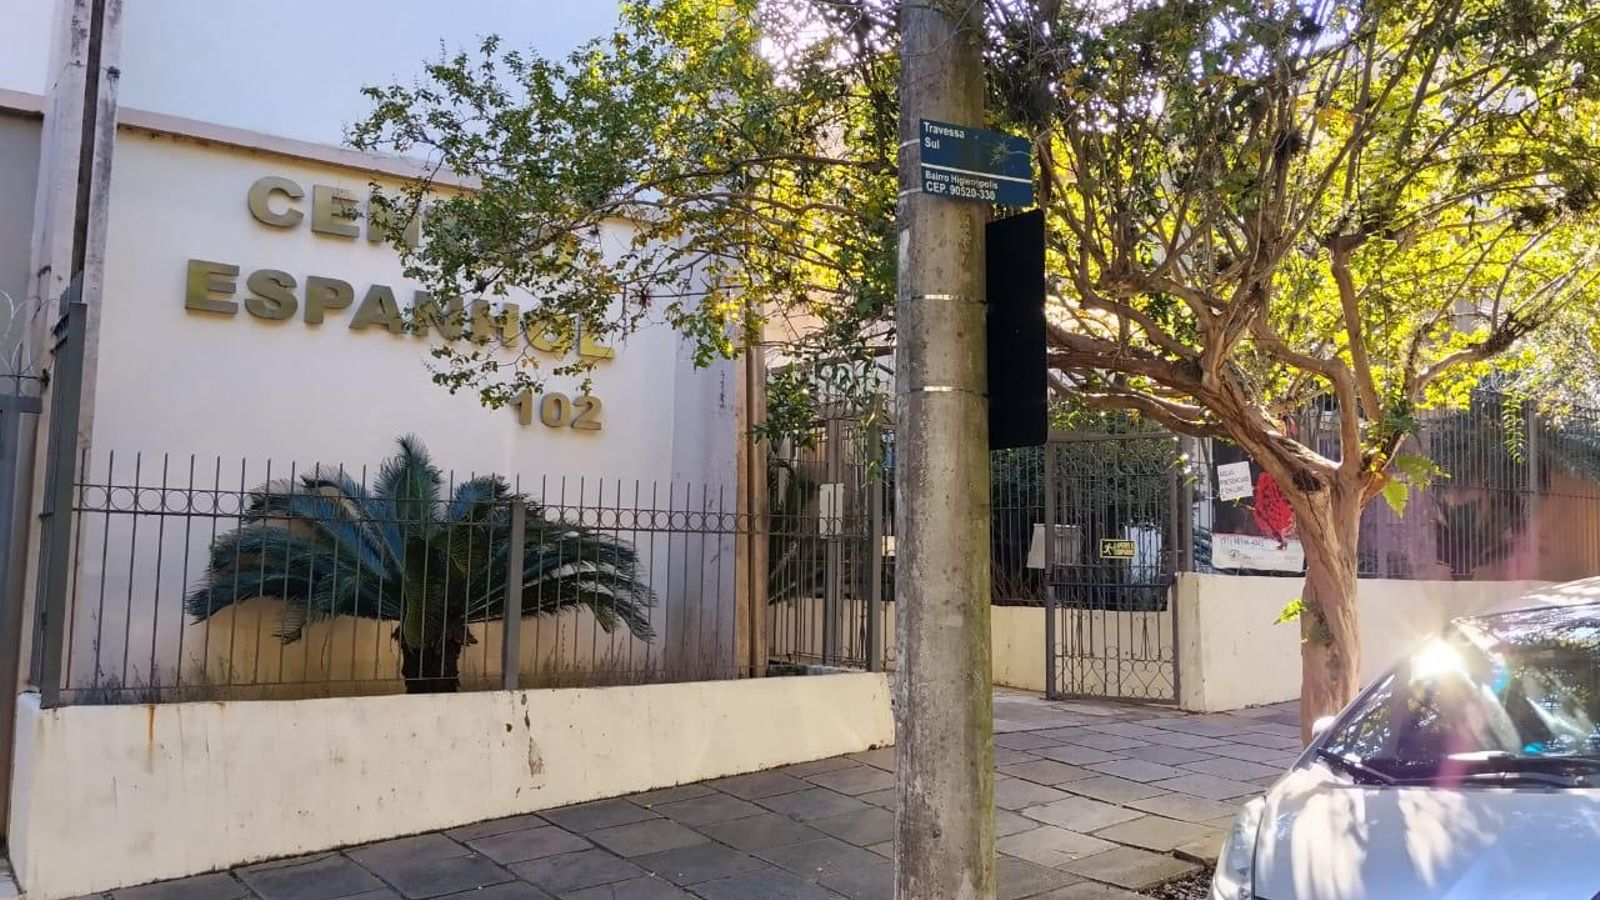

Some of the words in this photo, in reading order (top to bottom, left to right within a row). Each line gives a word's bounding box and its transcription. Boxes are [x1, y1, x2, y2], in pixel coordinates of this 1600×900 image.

[923, 122, 965, 139] Travessa
[924, 137, 940, 150] Sul
[925, 170, 949, 182] Bairro
[926, 181, 948, 194] CEP.
[949, 184, 996, 201] 90520-330
[185, 258, 615, 360] ESPANHOL
[508, 388, 603, 431] 102
